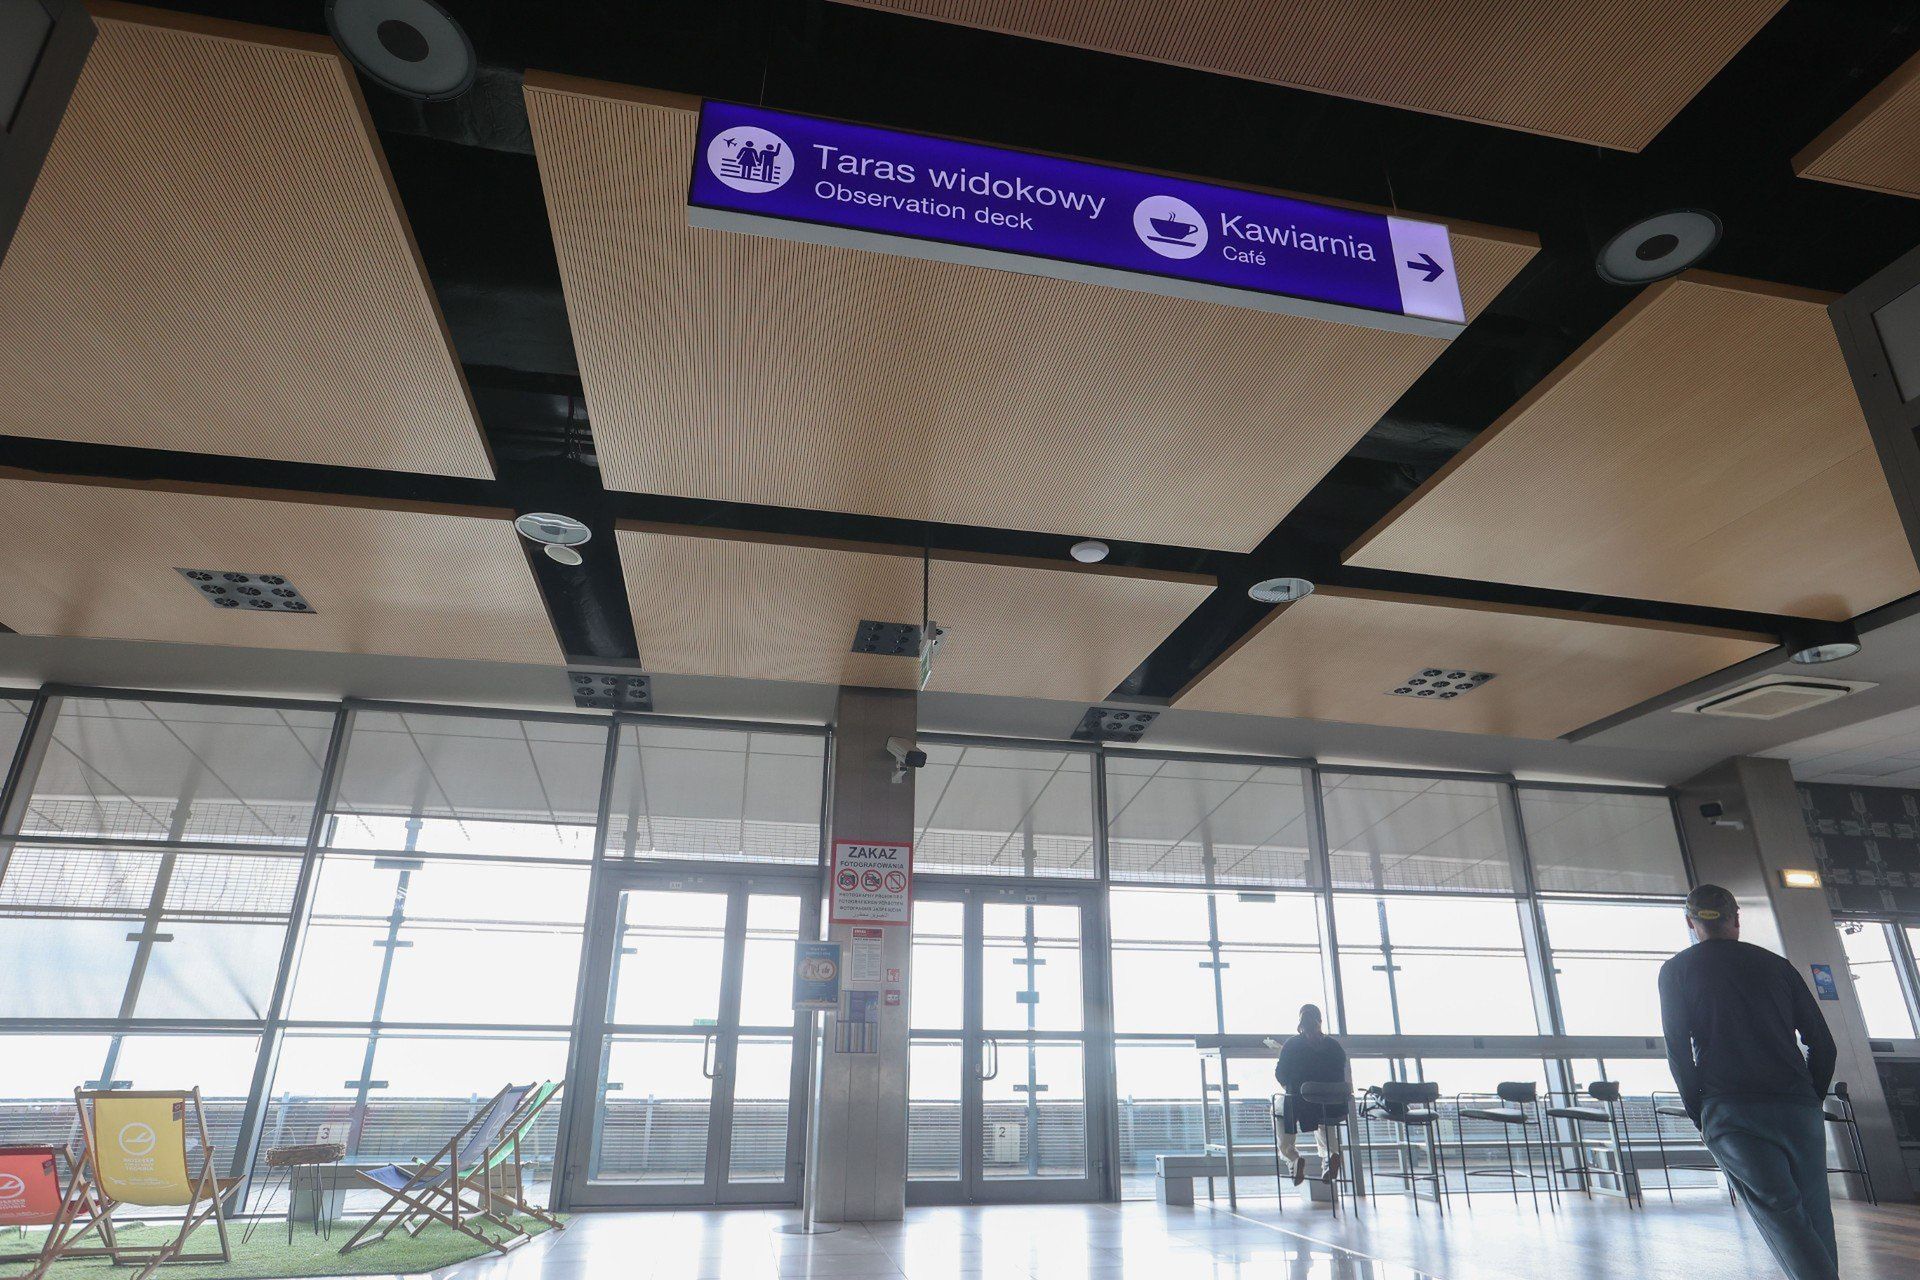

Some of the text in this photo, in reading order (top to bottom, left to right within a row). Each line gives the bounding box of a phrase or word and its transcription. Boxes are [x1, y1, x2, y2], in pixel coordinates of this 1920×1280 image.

[813, 143, 1106, 220] Taras widokowy
[815, 180, 1034, 231] Observation deck
[1220, 212, 1377, 263] Kawiarnia
[1222, 245, 1267, 267] Café
[848, 846, 897, 860] ZAKAZ
[840, 860, 904, 870] FOTOGRAFOWANIA
[320, 1127, 330, 1140] 3
[999, 1126, 1006, 1138] 2
